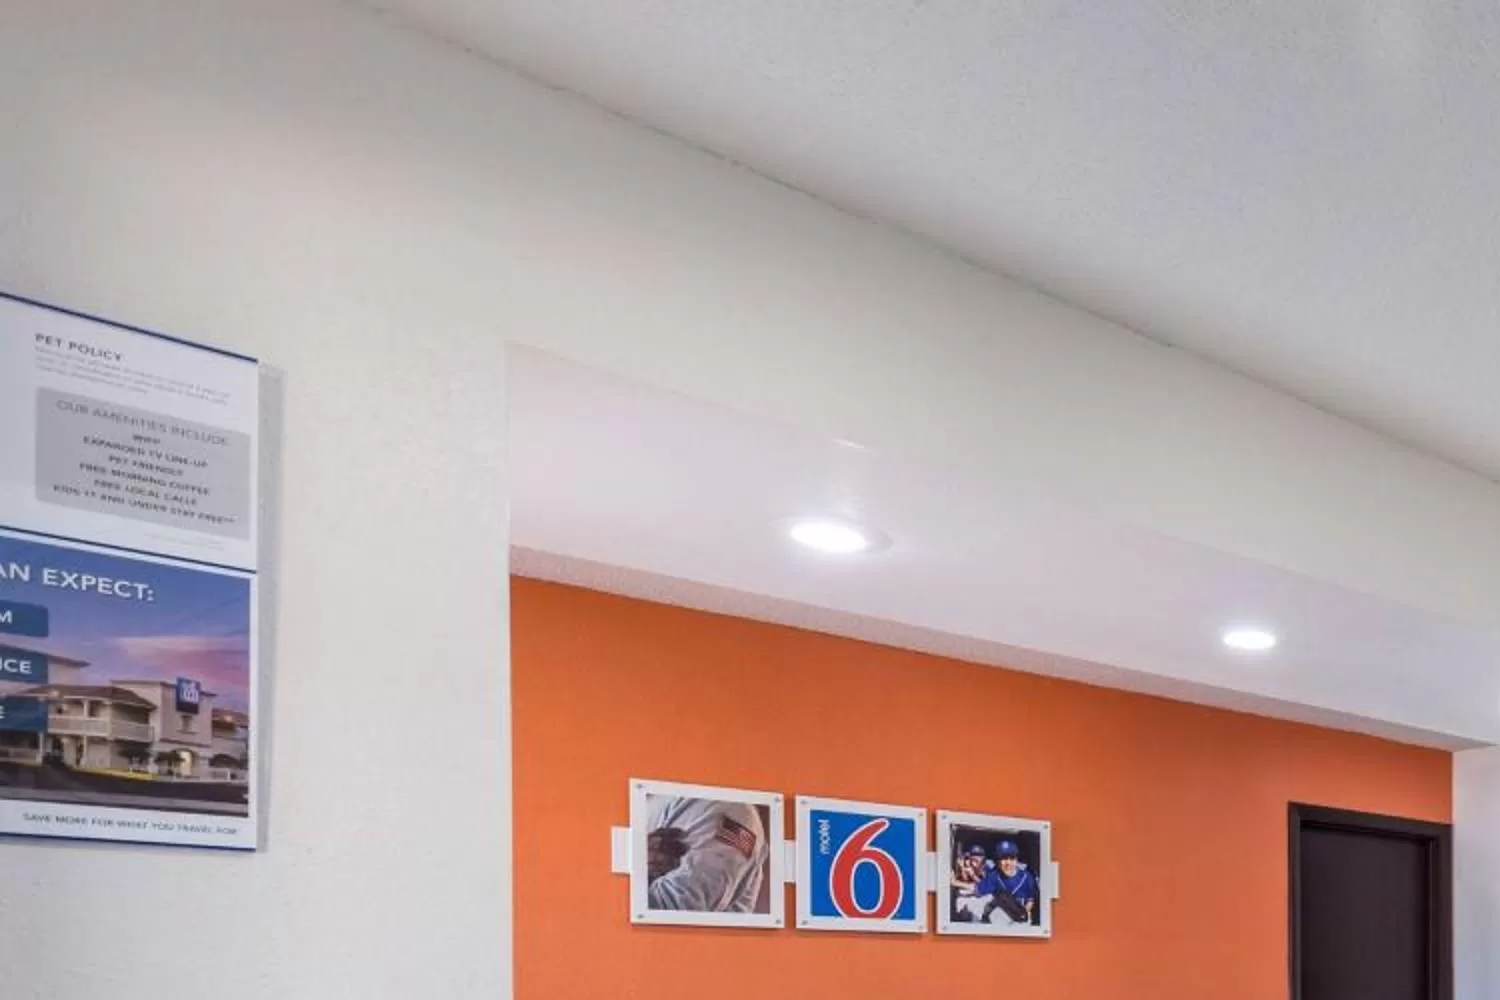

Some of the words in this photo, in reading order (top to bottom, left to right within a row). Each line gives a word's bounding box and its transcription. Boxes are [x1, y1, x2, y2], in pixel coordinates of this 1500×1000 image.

[35, 333, 61, 347] PET
[68, 341, 121, 362] POLICY
[56, 399, 88, 415] OUR
[92, 407, 168, 433] AMENITIES
[42, 567, 155, 601] EXPECT:
[817, 818, 831, 855] motel
[829, 818, 904, 920] 6
